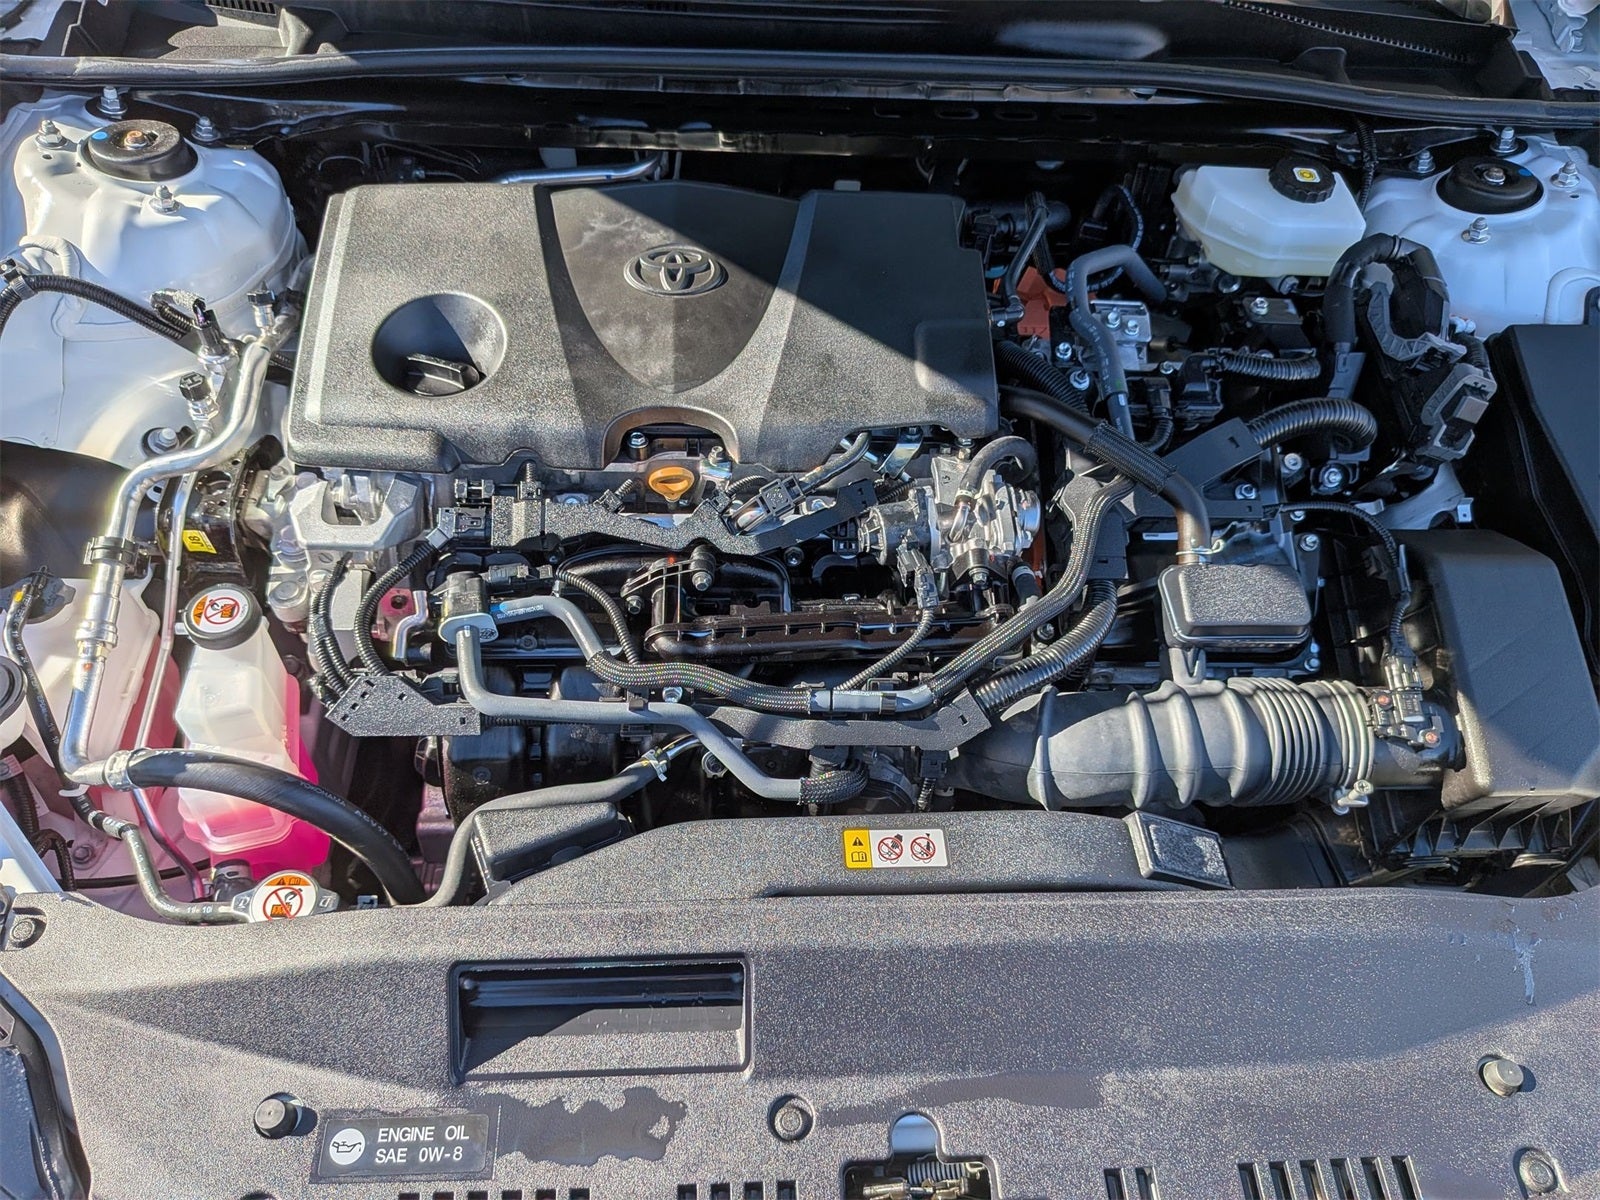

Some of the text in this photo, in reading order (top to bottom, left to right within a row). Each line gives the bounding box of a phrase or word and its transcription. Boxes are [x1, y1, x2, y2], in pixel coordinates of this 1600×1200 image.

[378, 1125, 470, 1143] ENGINE OIL
[375, 1146, 463, 1164] SAE 0W-8
